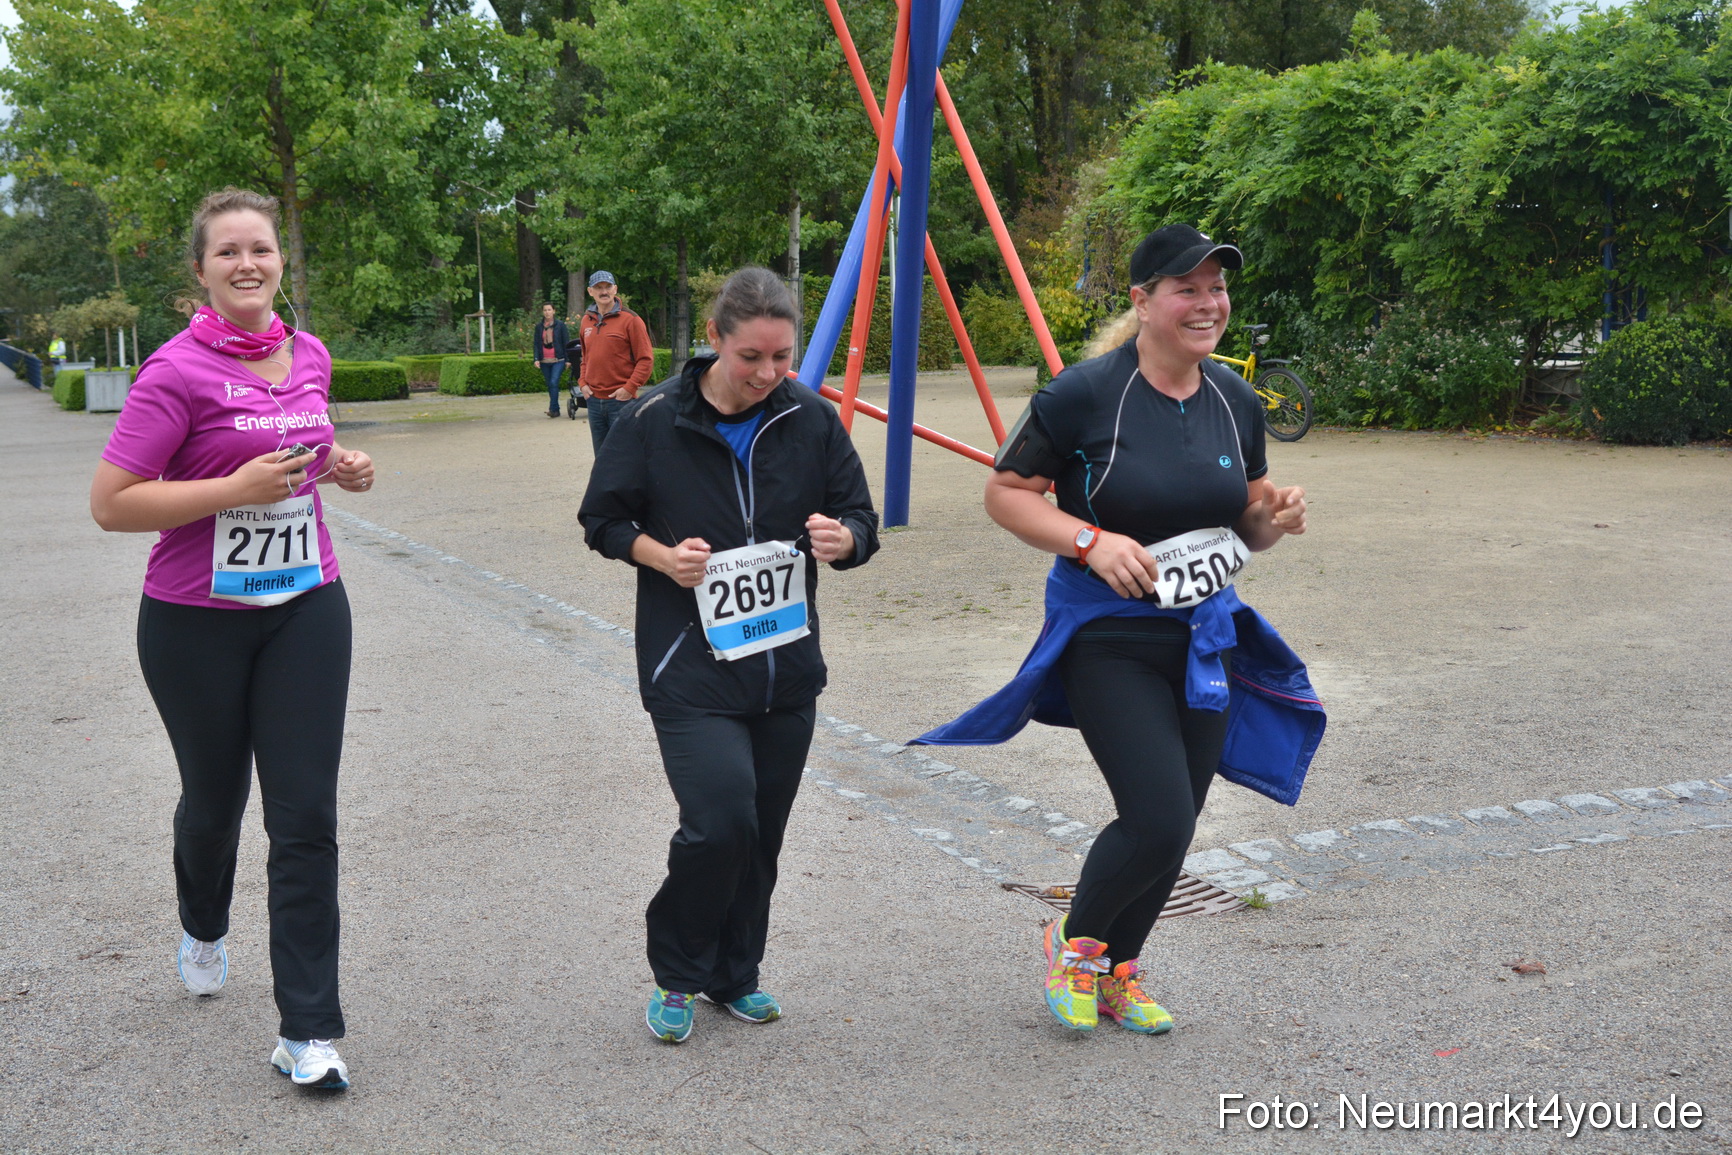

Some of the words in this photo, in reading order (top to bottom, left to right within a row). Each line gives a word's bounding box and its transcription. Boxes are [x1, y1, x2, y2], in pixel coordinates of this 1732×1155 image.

[219, 509, 260, 521] PARTL
[263, 508, 305, 521] Neumarkt
[226, 522, 309, 566] 2711
[1153, 547, 1187, 564] ARTL
[1187, 533, 1231, 554] Neumarkt
[735, 550, 786, 569] Neumarkt
[244, 574, 295, 592] Henrike
[1163, 546, 1244, 605] 2504
[708, 563, 795, 620] 2697
[742, 619, 778, 640] Britta
